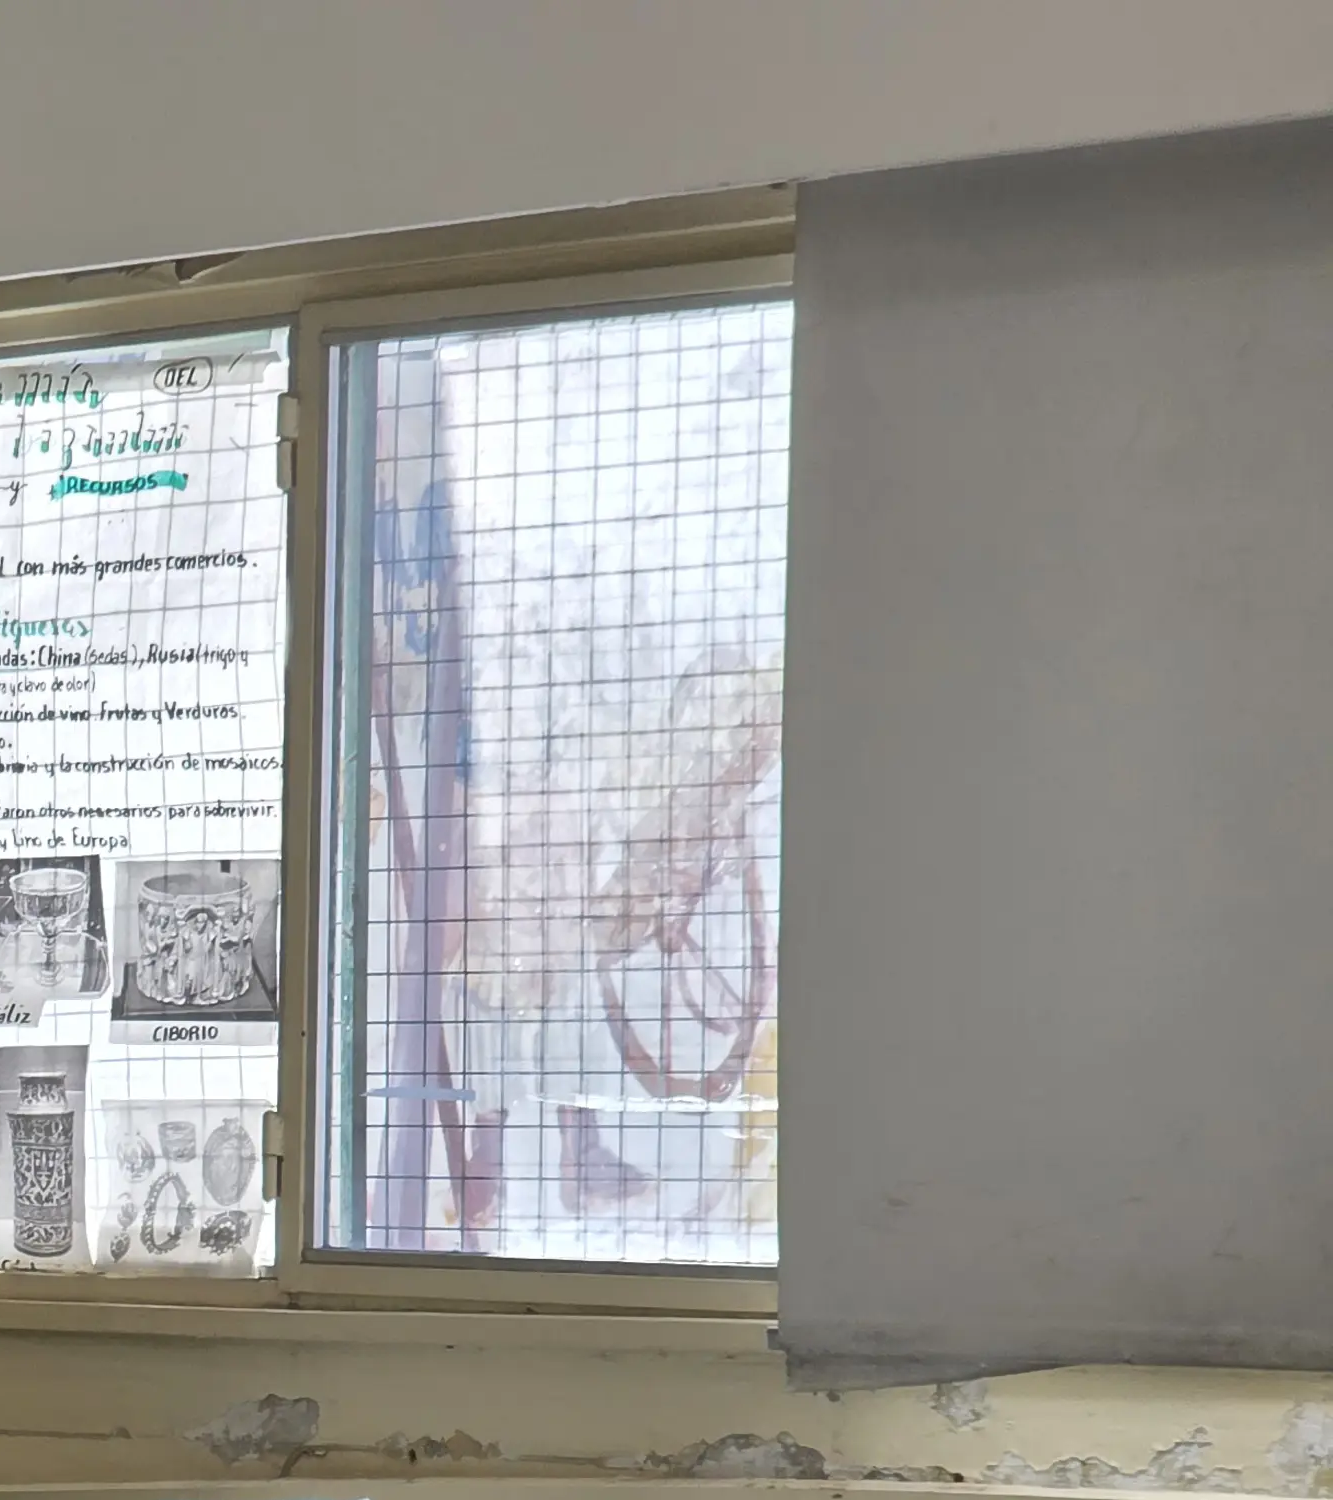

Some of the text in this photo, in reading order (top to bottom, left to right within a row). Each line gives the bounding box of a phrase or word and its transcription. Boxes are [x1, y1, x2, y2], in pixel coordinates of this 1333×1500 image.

[163, 365, 199, 388] DEL
[66, 474, 159, 496] RECURSOS
[16, 560, 44, 577] con
[51, 554, 87, 576] más
[94, 553, 162, 581] grandes
[51, 677, 64, 692] de
[37, 704, 55, 721] de
[182, 753, 201, 771] de
[39, 801, 73, 818] otros
[168, 805, 201, 820] para
[47, 828, 66, 848] de
[72, 826, 129, 853] Europa
[152, 1025, 219, 1043] CIBORIO
